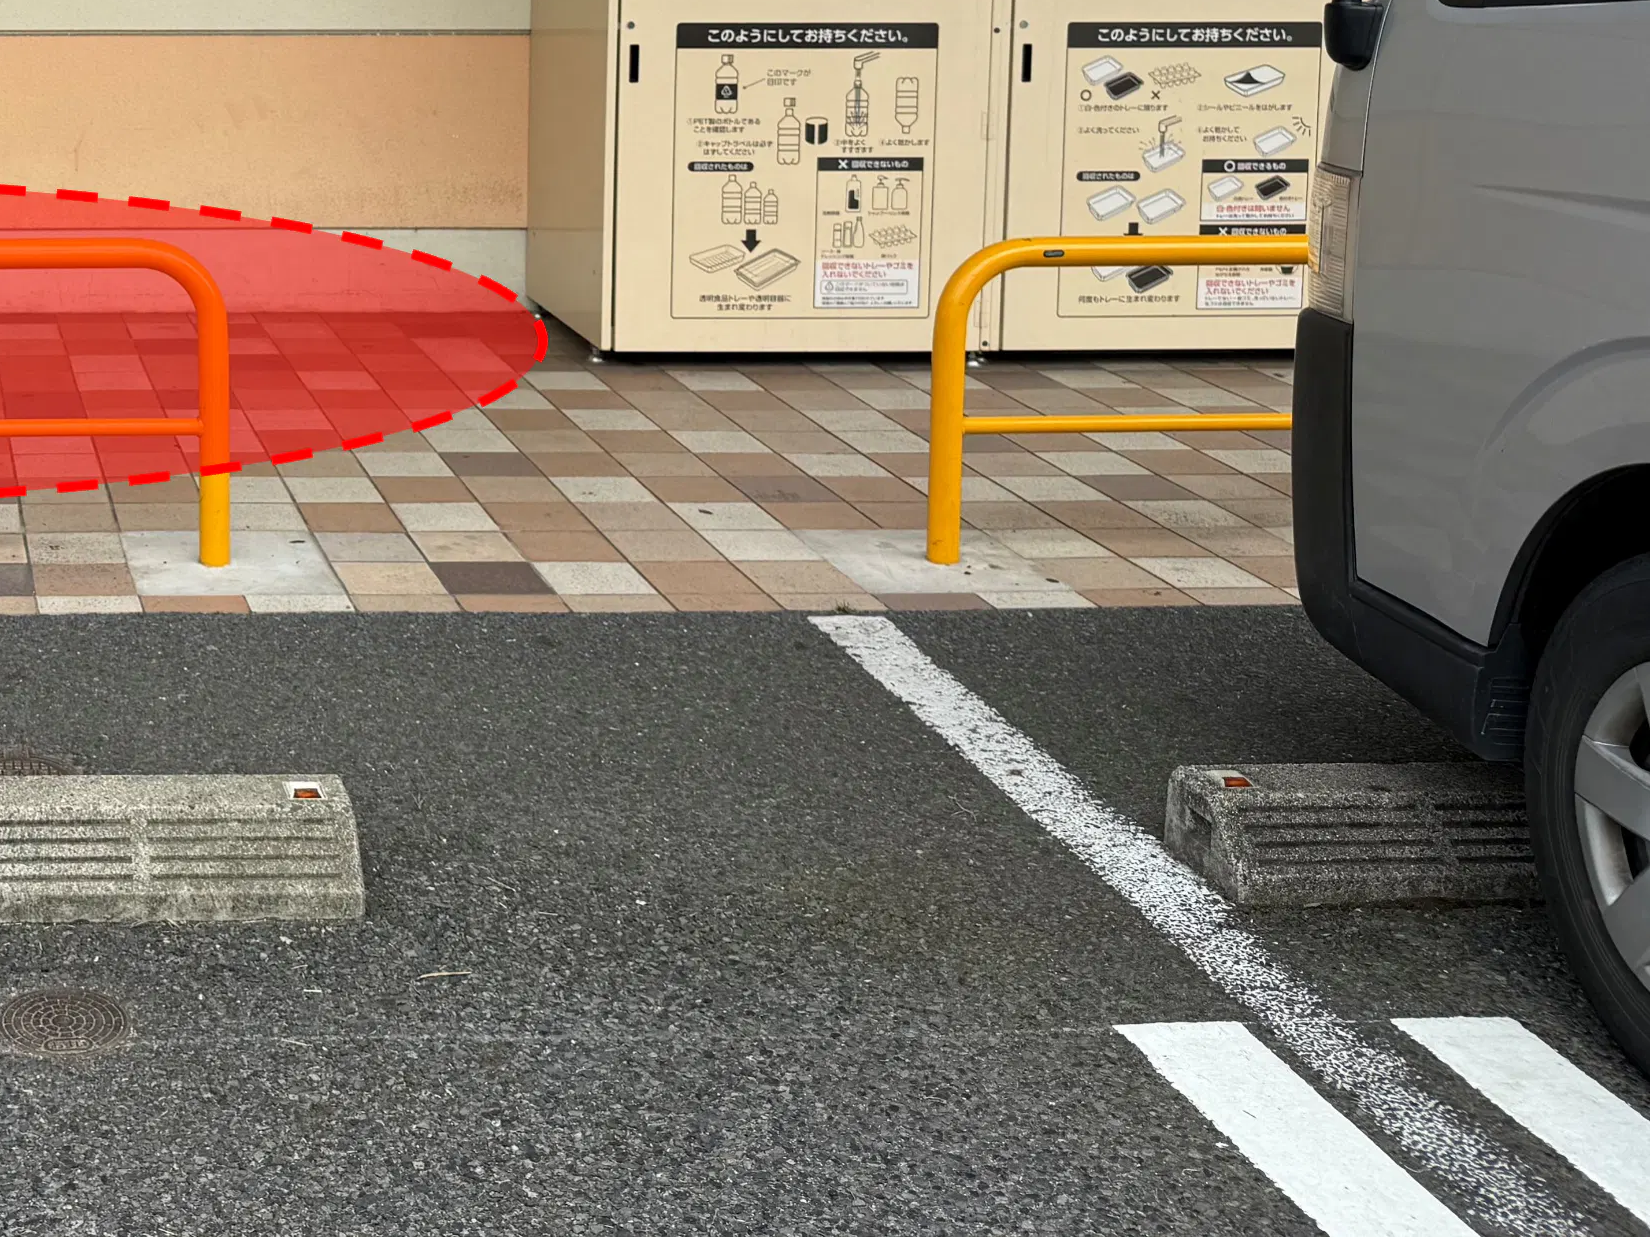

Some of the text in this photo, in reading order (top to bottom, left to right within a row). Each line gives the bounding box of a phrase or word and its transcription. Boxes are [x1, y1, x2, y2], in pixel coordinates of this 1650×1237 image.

[707, 28, 909, 43] このようにしてお持ちください。
[1097, 27, 1293, 42] このようにしてお持ちください。
